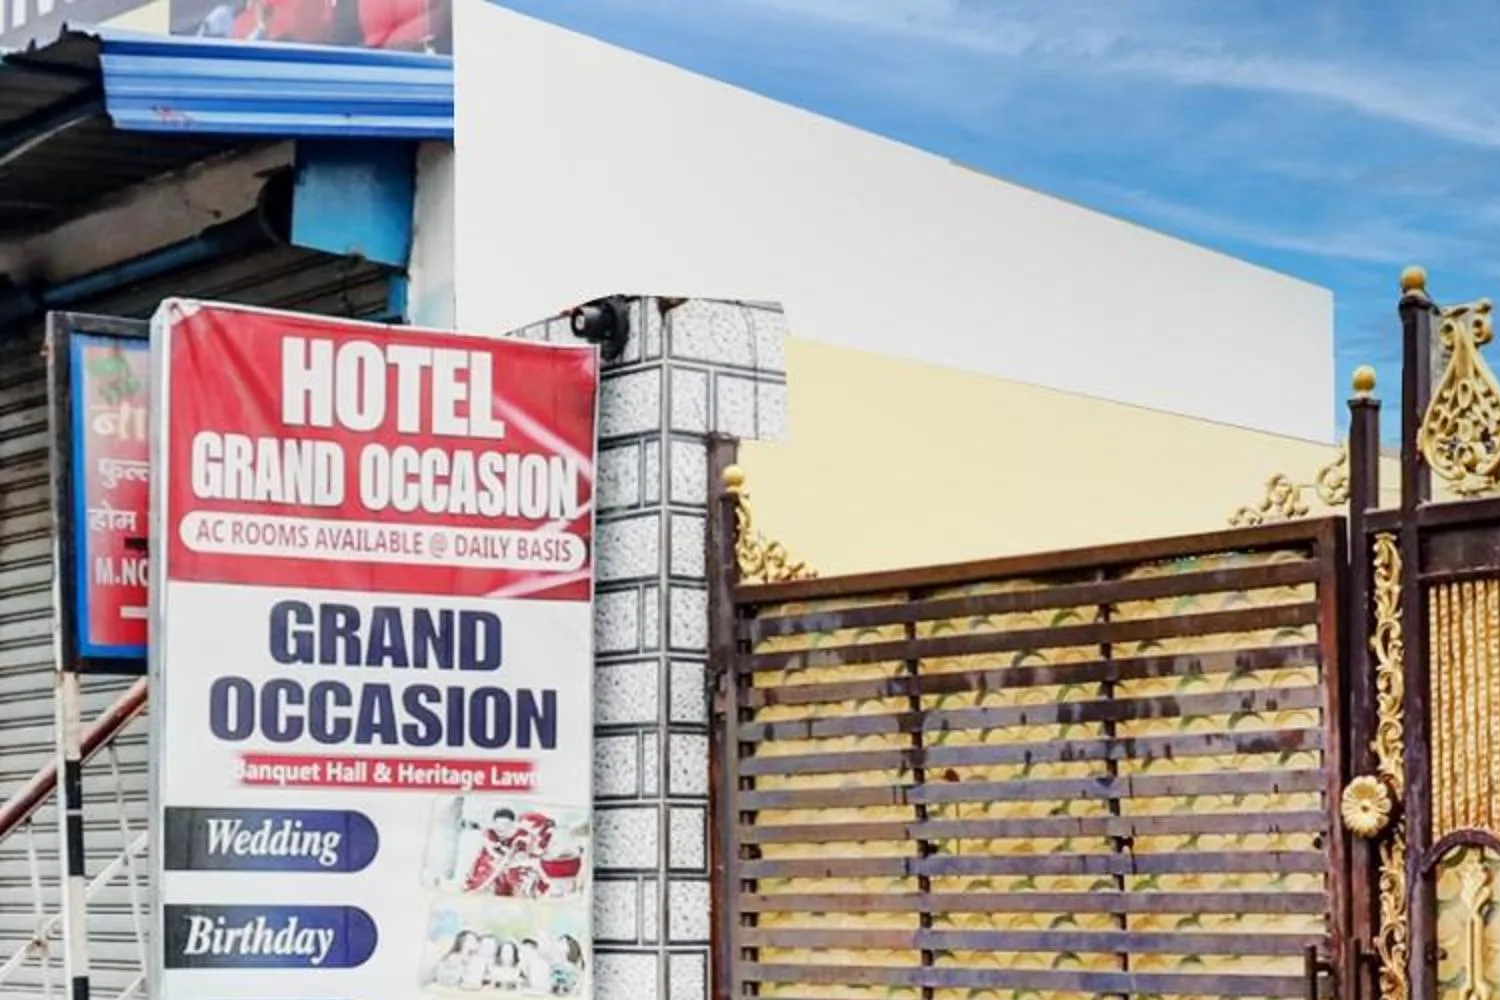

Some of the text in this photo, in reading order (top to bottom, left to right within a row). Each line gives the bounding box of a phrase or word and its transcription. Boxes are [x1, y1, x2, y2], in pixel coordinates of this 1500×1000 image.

[281, 336, 505, 438] HOTEL
[192, 431, 578, 519] GRAND OCCASION
[196, 519, 224, 545] AC
[231, 519, 308, 548] ROOMS
[315, 527, 423, 556] AVAILABLE
[455, 535, 509, 560] DAILY
[517, 538, 572, 562] BASIS
[269, 599, 502, 671] GRAND
[209, 676, 557, 750] OCCASION
[231, 758, 321, 785] Banquet
[326, 761, 368, 783] Hall
[373, 762, 392, 784] &
[398, 763, 485, 791] Heritage
[206, 818, 342, 867] Wedding
[184, 915, 335, 964] Birthday
